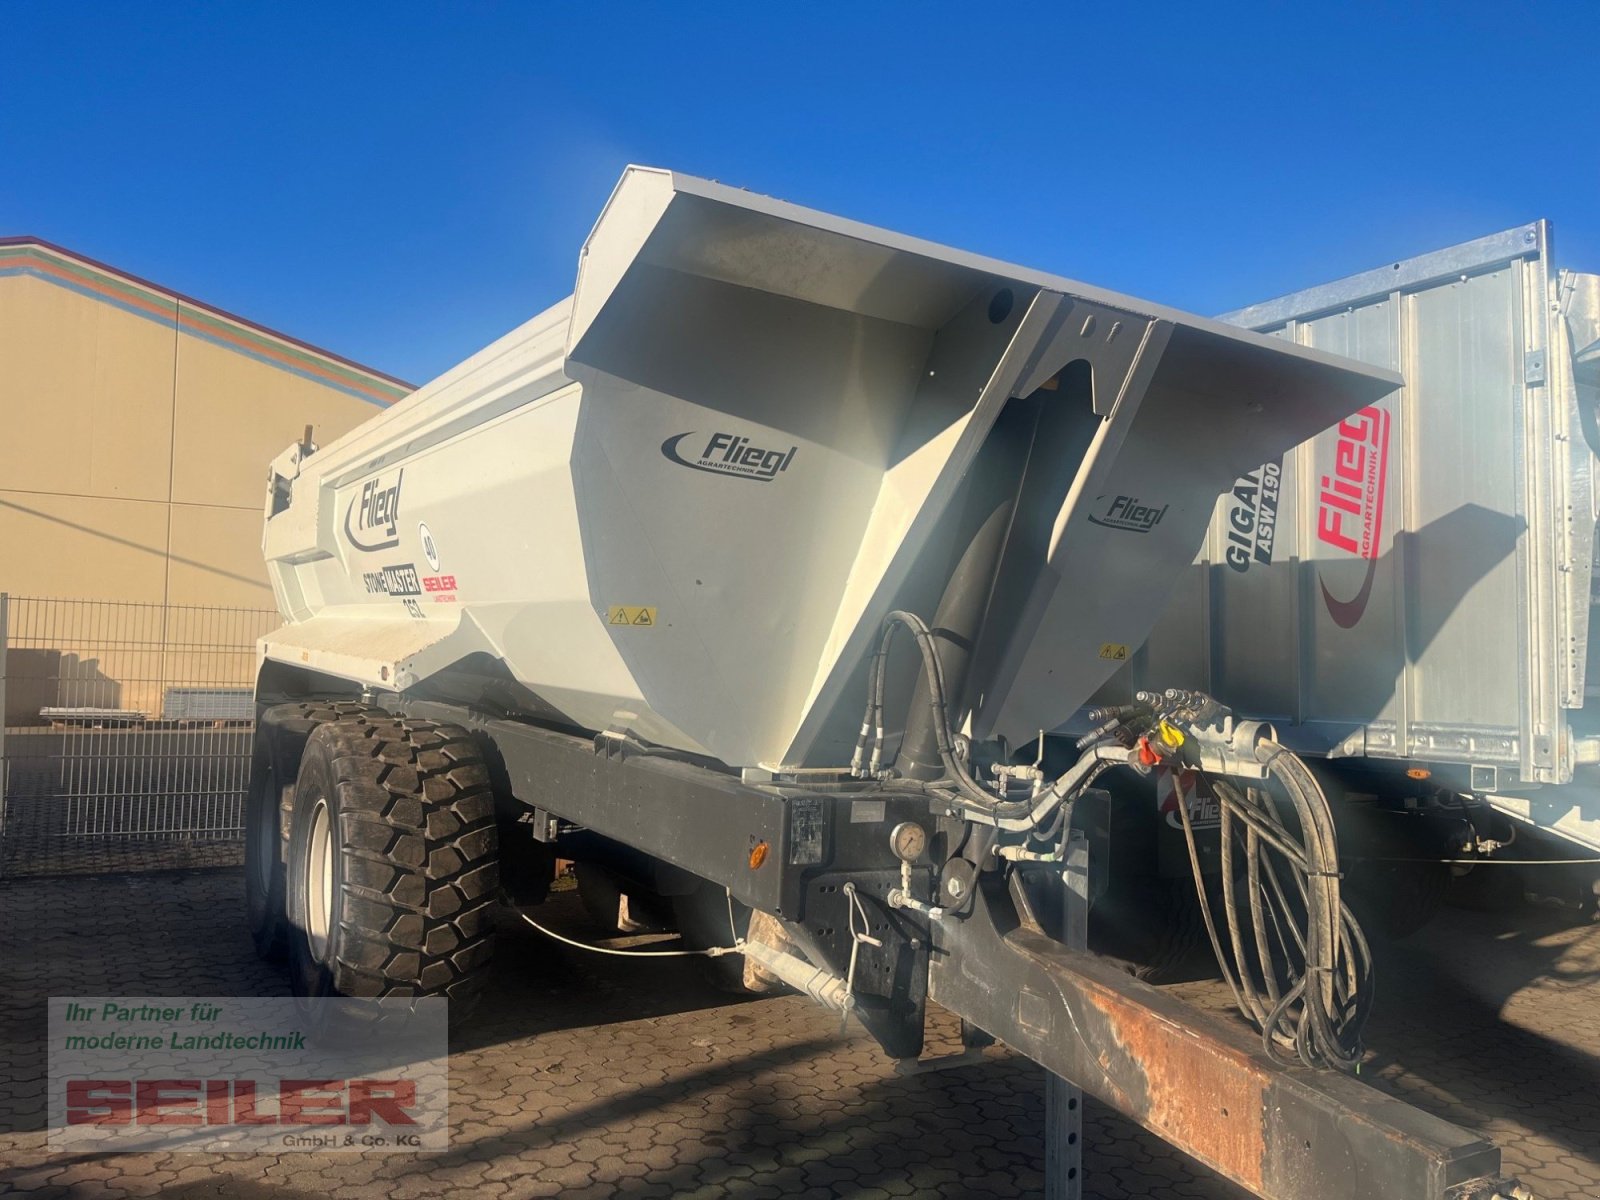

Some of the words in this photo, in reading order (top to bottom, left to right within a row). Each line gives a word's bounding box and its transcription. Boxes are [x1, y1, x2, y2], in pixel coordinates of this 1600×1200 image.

[697, 460, 755, 474] AGRARTECHNIK
[702, 432, 798, 477] Fliegl
[1262, 462, 1281, 502] 190
[1318, 405, 1381, 554] Flieg
[359, 468, 404, 537] Fliegl
[1106, 495, 1170, 529] Fliegl
[1362, 450, 1378, 560] AGRARTECHNIK
[1256, 503, 1276, 554] ASW
[422, 575, 458, 592] SEILER
